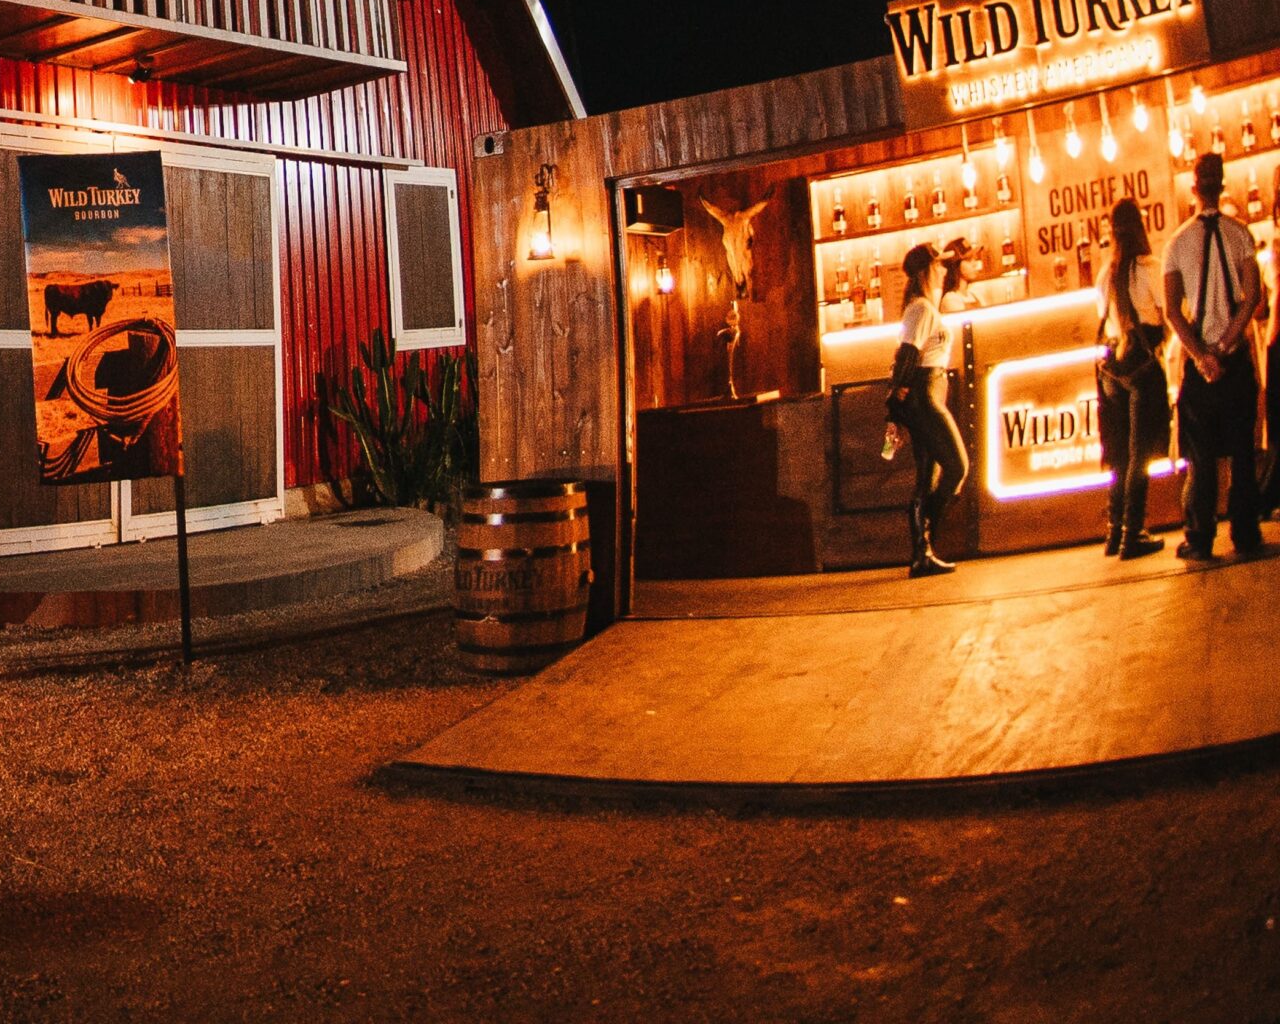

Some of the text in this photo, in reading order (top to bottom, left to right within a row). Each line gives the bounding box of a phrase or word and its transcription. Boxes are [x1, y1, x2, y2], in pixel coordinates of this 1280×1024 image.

[887, 3, 1019, 76] WILD
[950, 64, 1039, 107] WHISKEY
[48, 186, 141, 208] WILD TURKEY
[1122, 169, 1150, 200] NO
[74, 209, 120, 221] BOURBON
